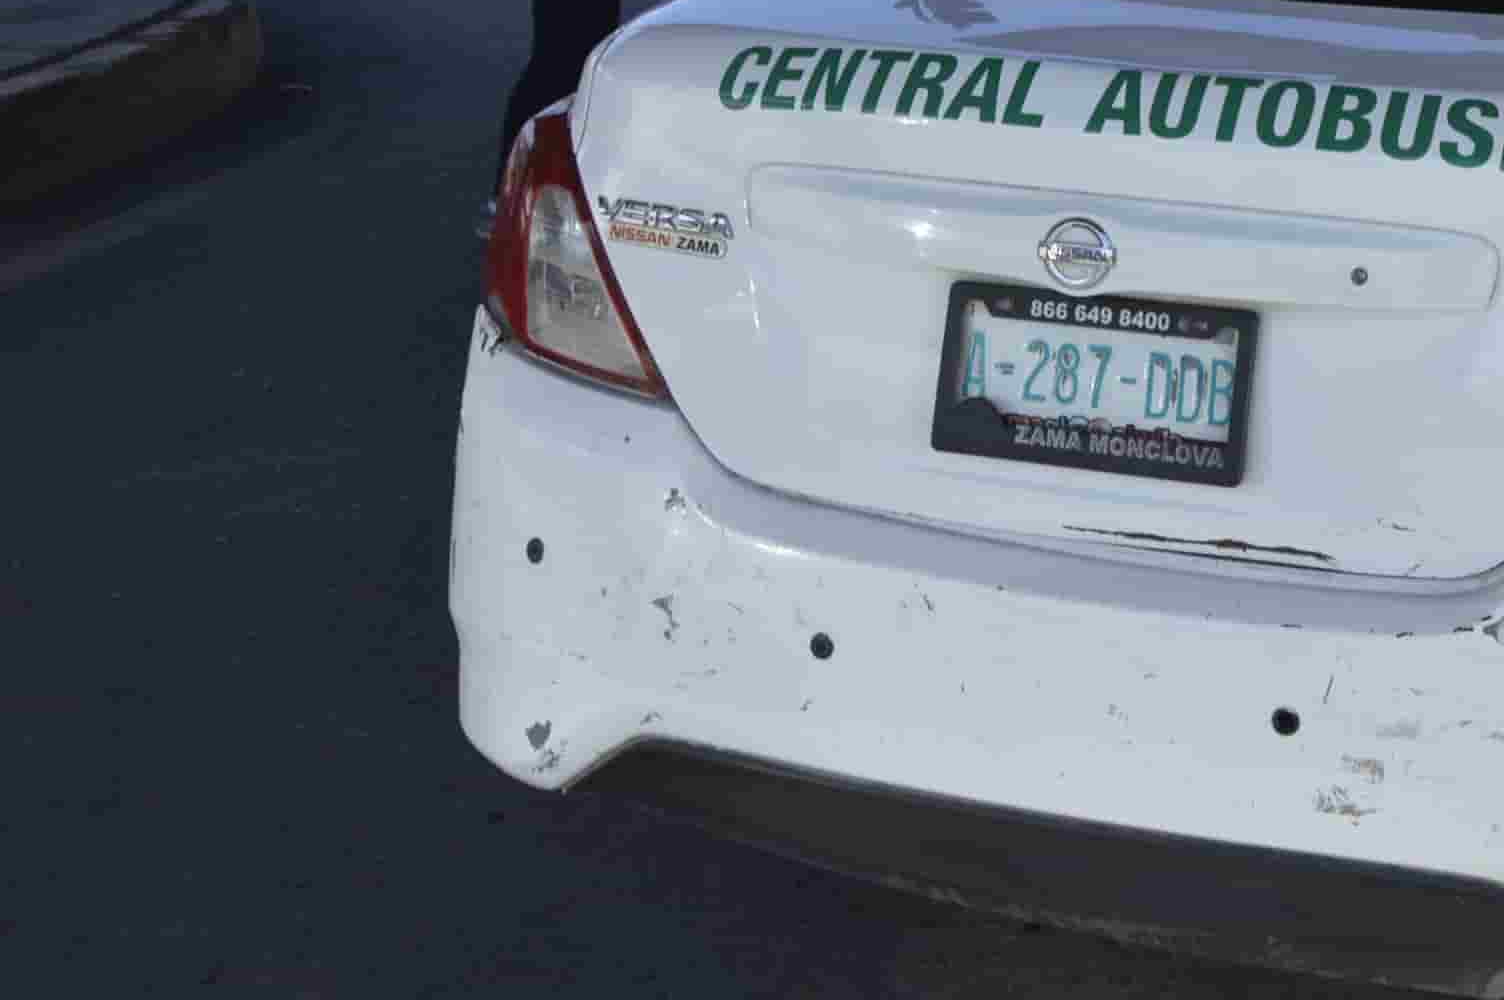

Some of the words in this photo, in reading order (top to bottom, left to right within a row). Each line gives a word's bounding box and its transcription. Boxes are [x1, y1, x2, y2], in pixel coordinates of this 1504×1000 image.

[718, 44, 1045, 129] CENTRAL
[598, 194, 736, 241] VERSA
[608, 223, 672, 247] NISSAN
[676, 235, 721, 257] ZAMA
[1030, 299, 1068, 320] 866
[1074, 304, 1112, 326] 649
[1118, 310, 1171, 332] 8400
[1013, 424, 1082, 451] ZAMA
[1089, 434, 1225, 469] MONCLOVA
